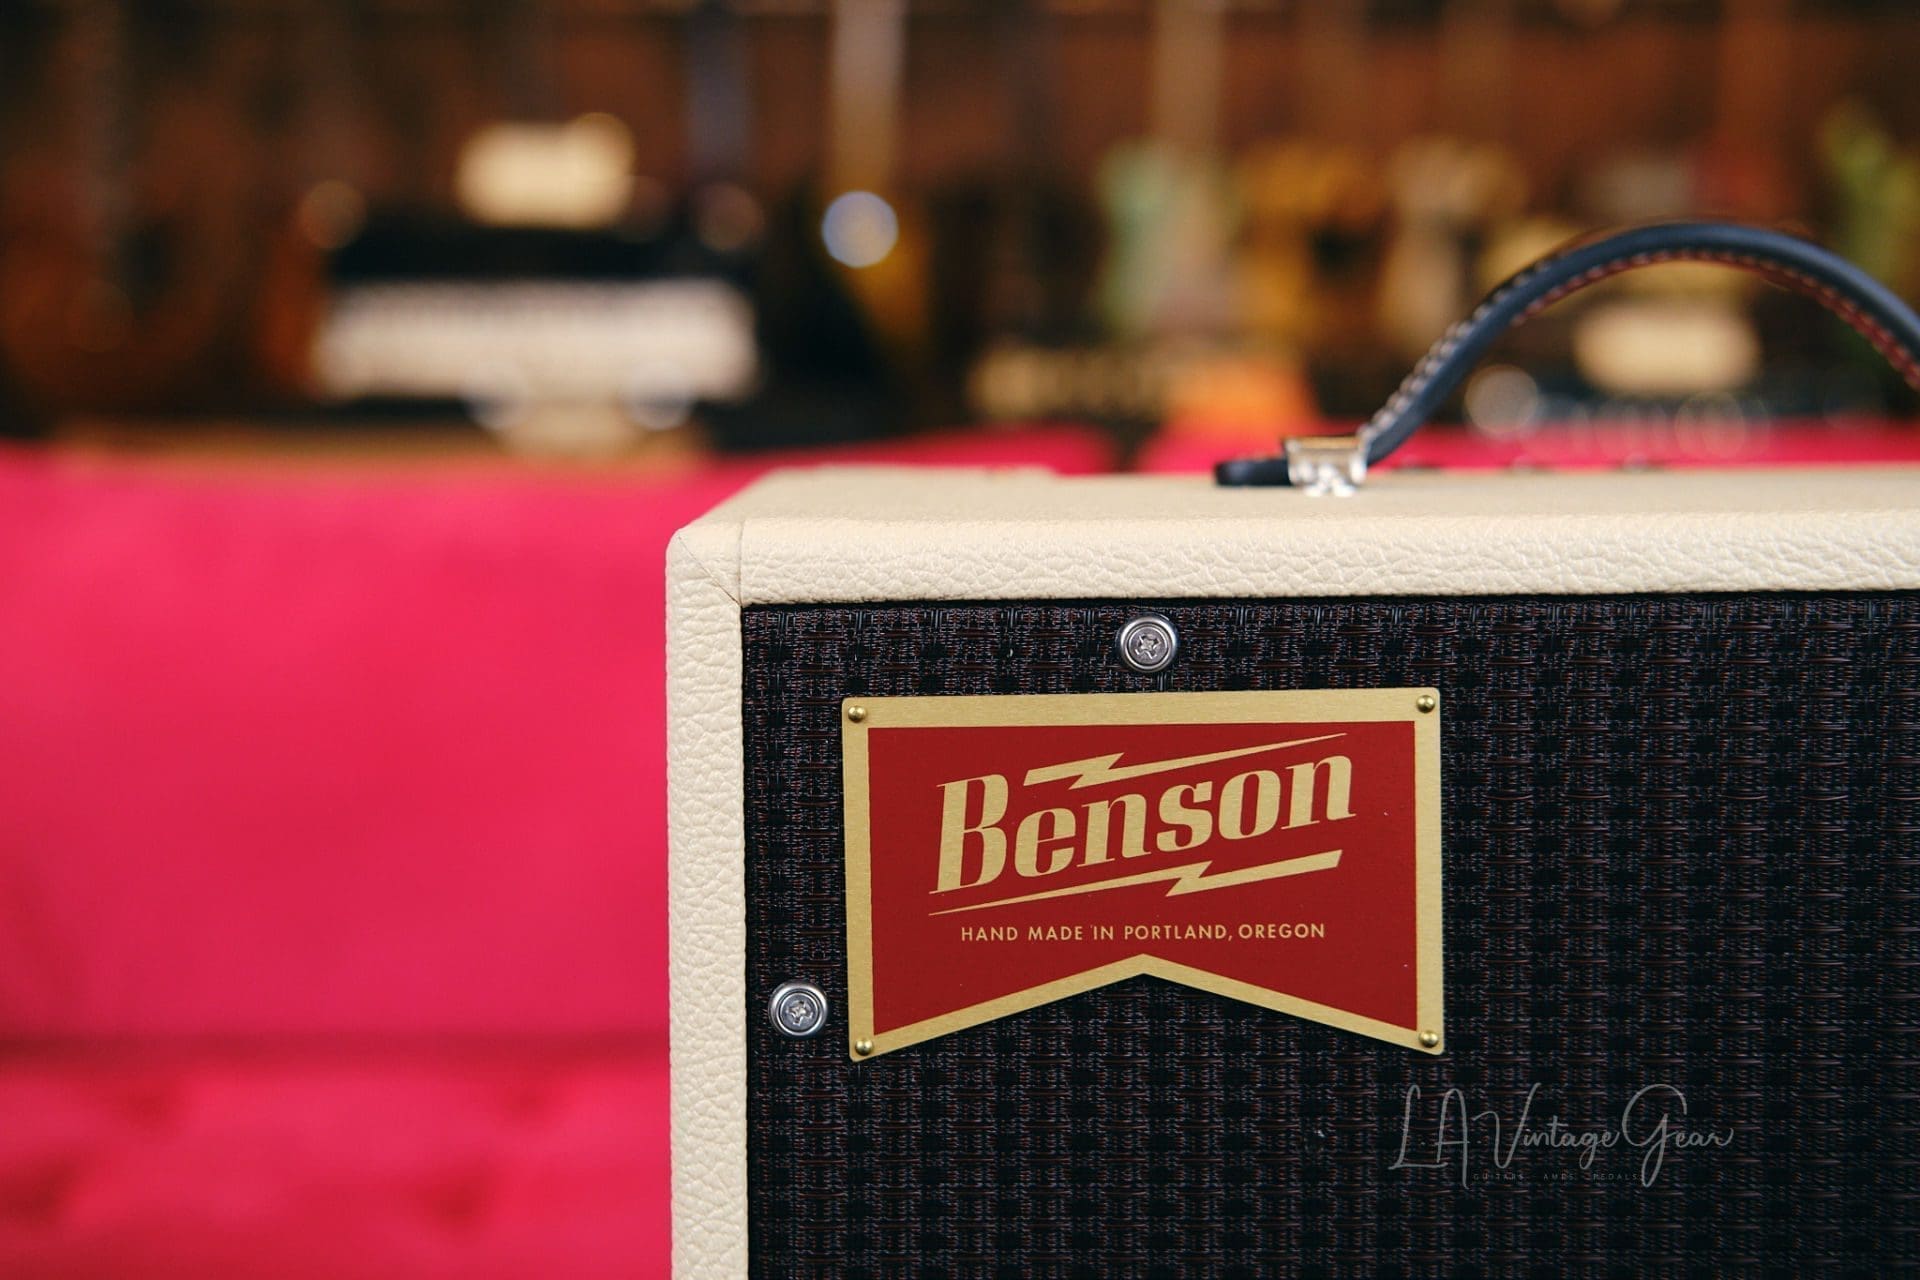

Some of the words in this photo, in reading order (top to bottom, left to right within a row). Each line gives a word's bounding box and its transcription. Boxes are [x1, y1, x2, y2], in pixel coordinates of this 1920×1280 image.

[929, 755, 1357, 894] Benson
[961, 926, 1018, 941] HAND
[1028, 926, 1083, 941] MADE
[1093, 926, 1114, 940] IN
[1124, 925, 1233, 943] PORTLAND,
[1238, 923, 1325, 939] OREGON
